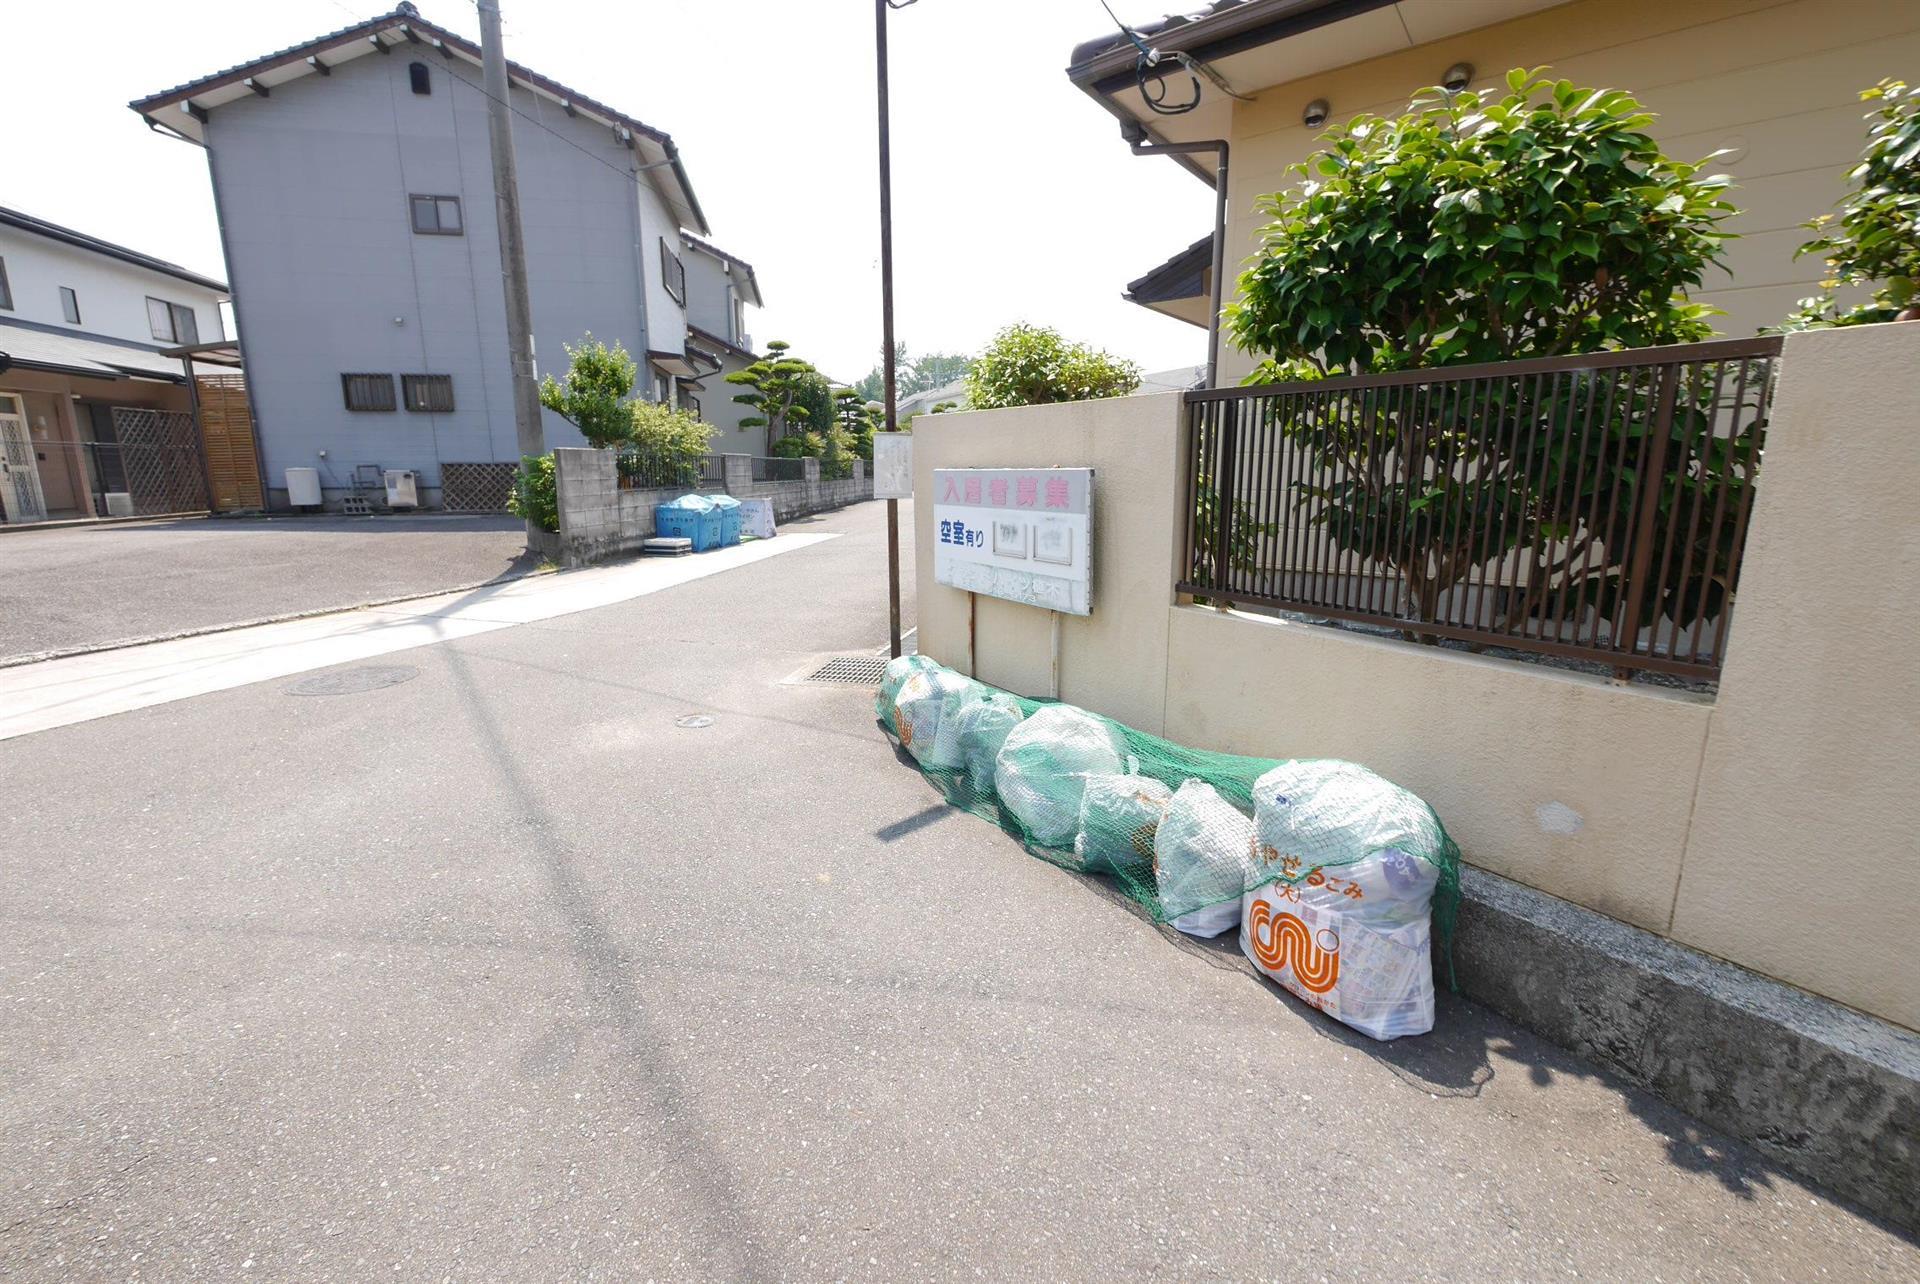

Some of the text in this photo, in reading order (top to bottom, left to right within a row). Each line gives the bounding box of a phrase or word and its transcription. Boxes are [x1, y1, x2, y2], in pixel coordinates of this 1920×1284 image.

[944, 478, 1070, 507] 入居者募集
[941, 519, 984, 547] 空室有り
